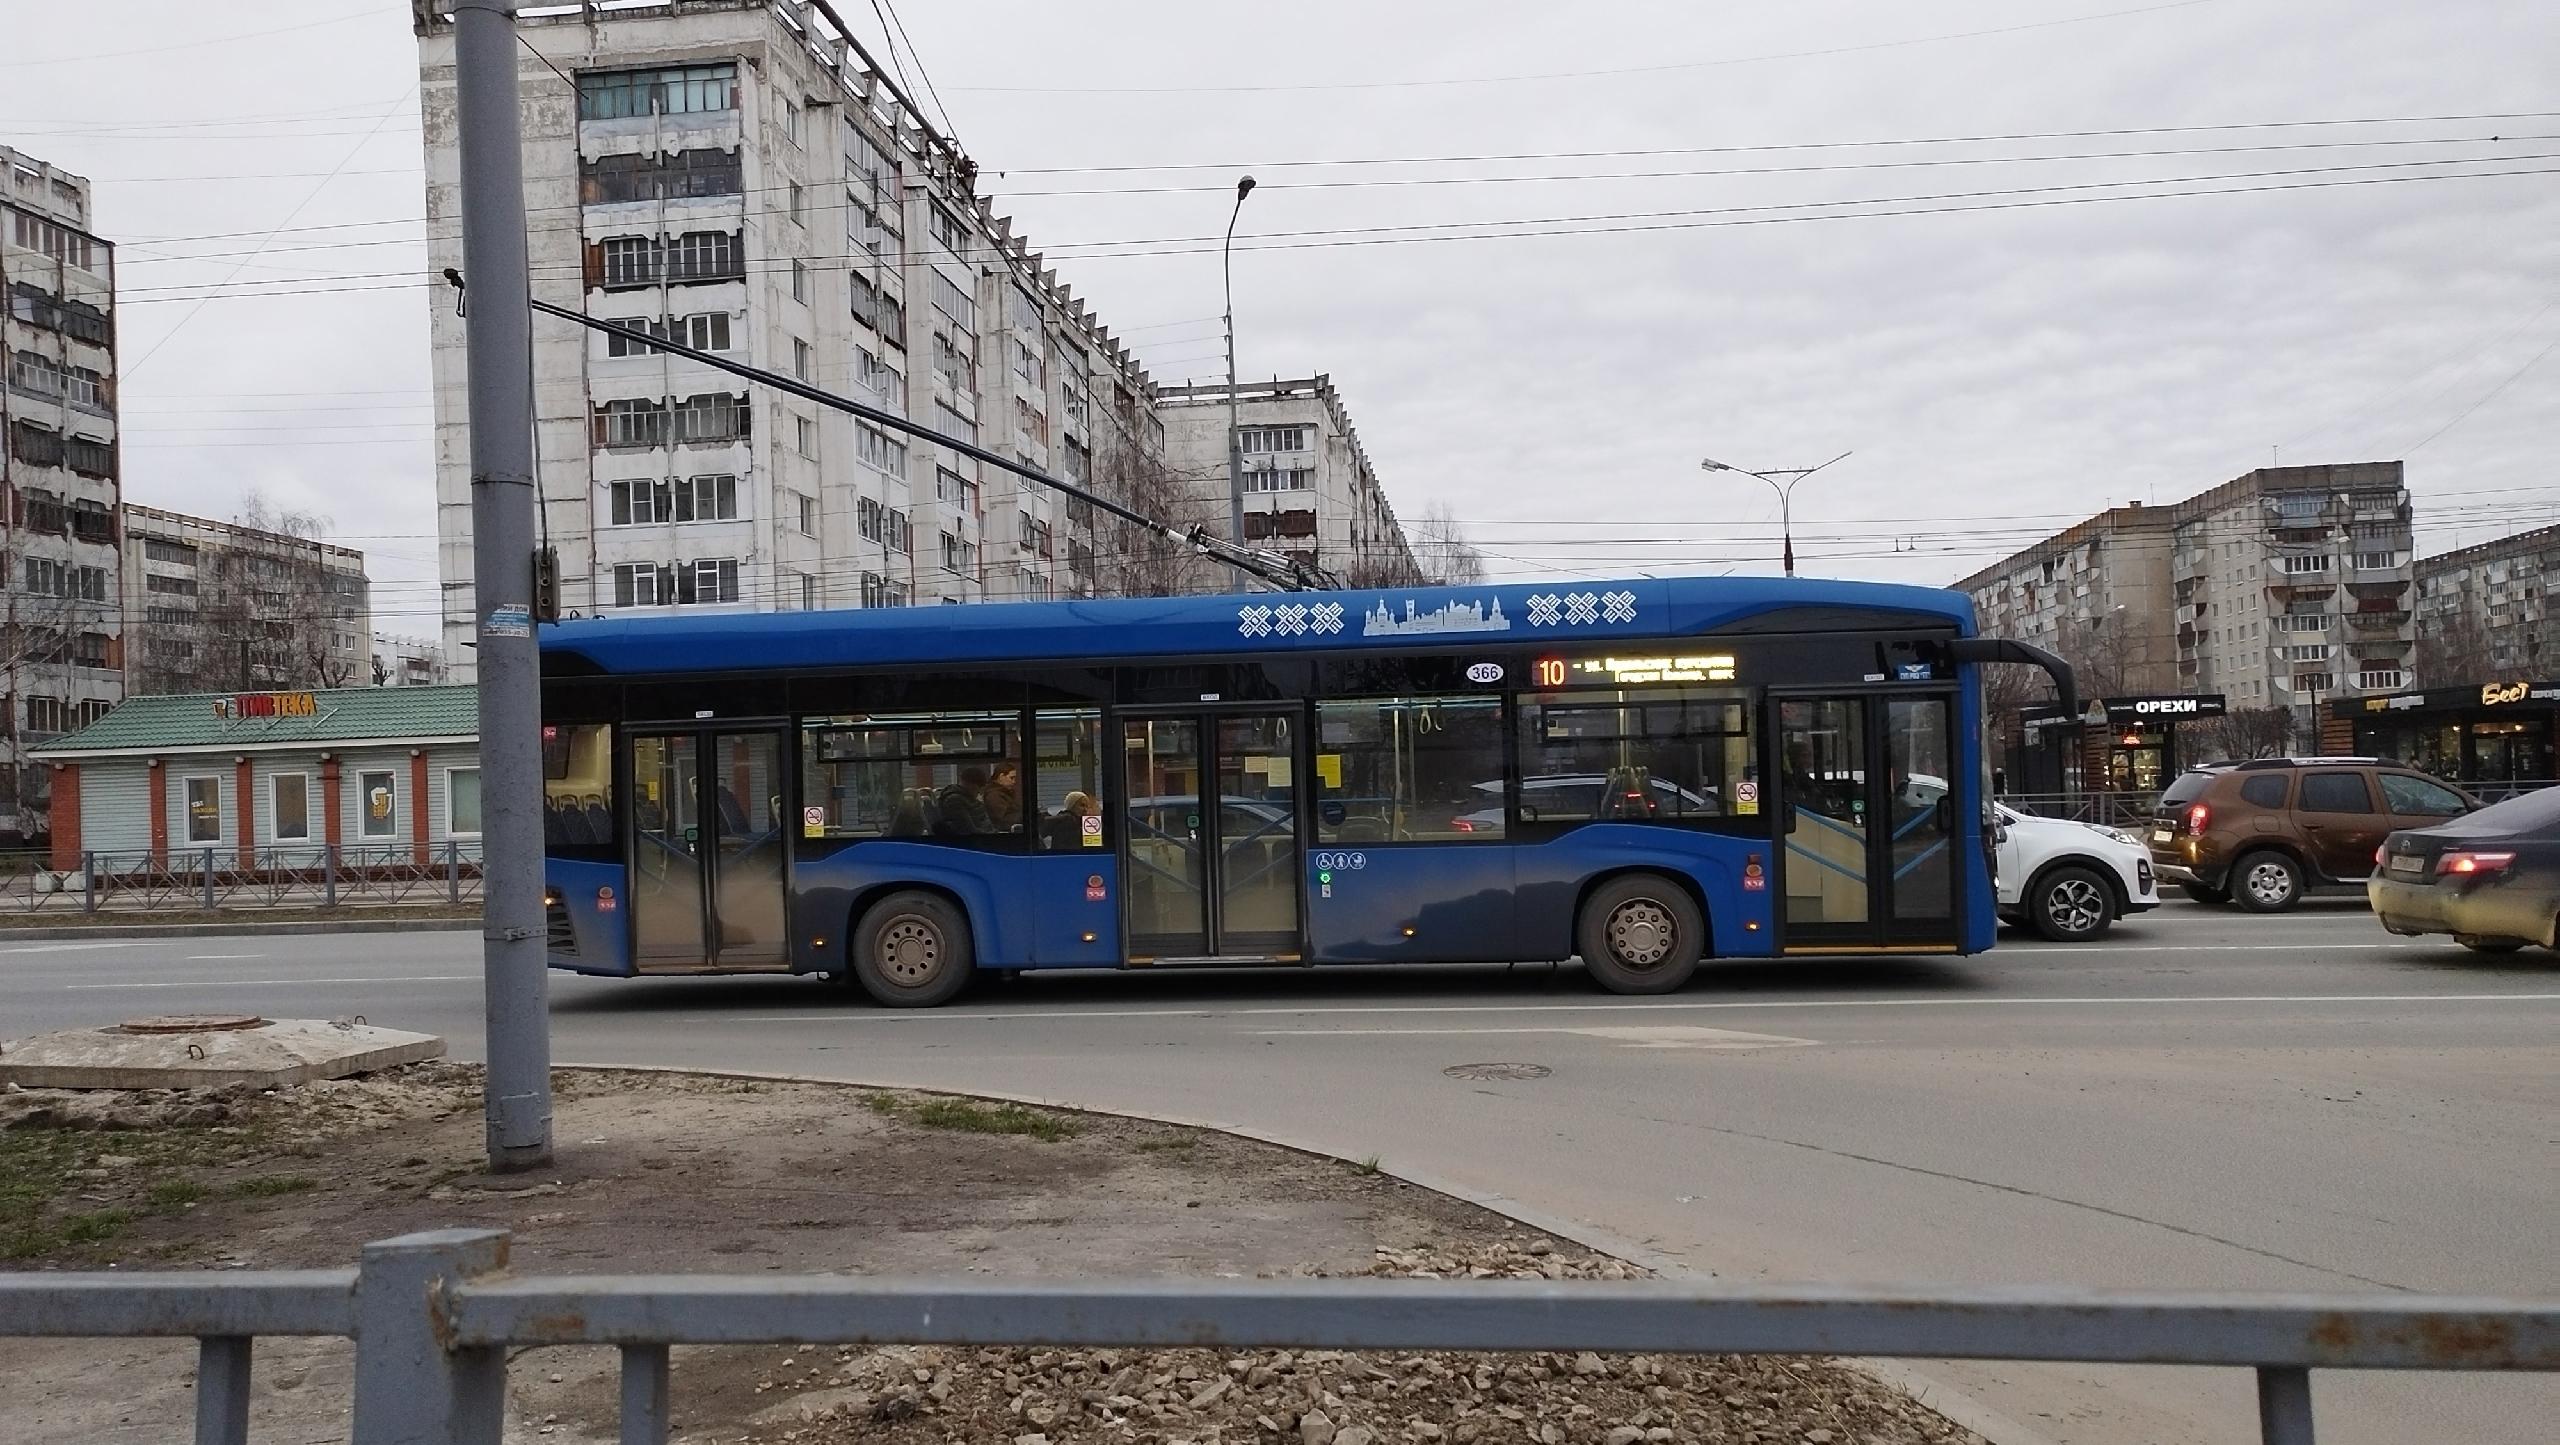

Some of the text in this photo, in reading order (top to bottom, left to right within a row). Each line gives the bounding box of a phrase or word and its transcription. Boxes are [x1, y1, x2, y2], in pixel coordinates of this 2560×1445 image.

[1472, 666, 1499, 680] 366
[1540, 660, 1565, 686] 10
[2135, 699, 2197, 713] ОРЕХИ
